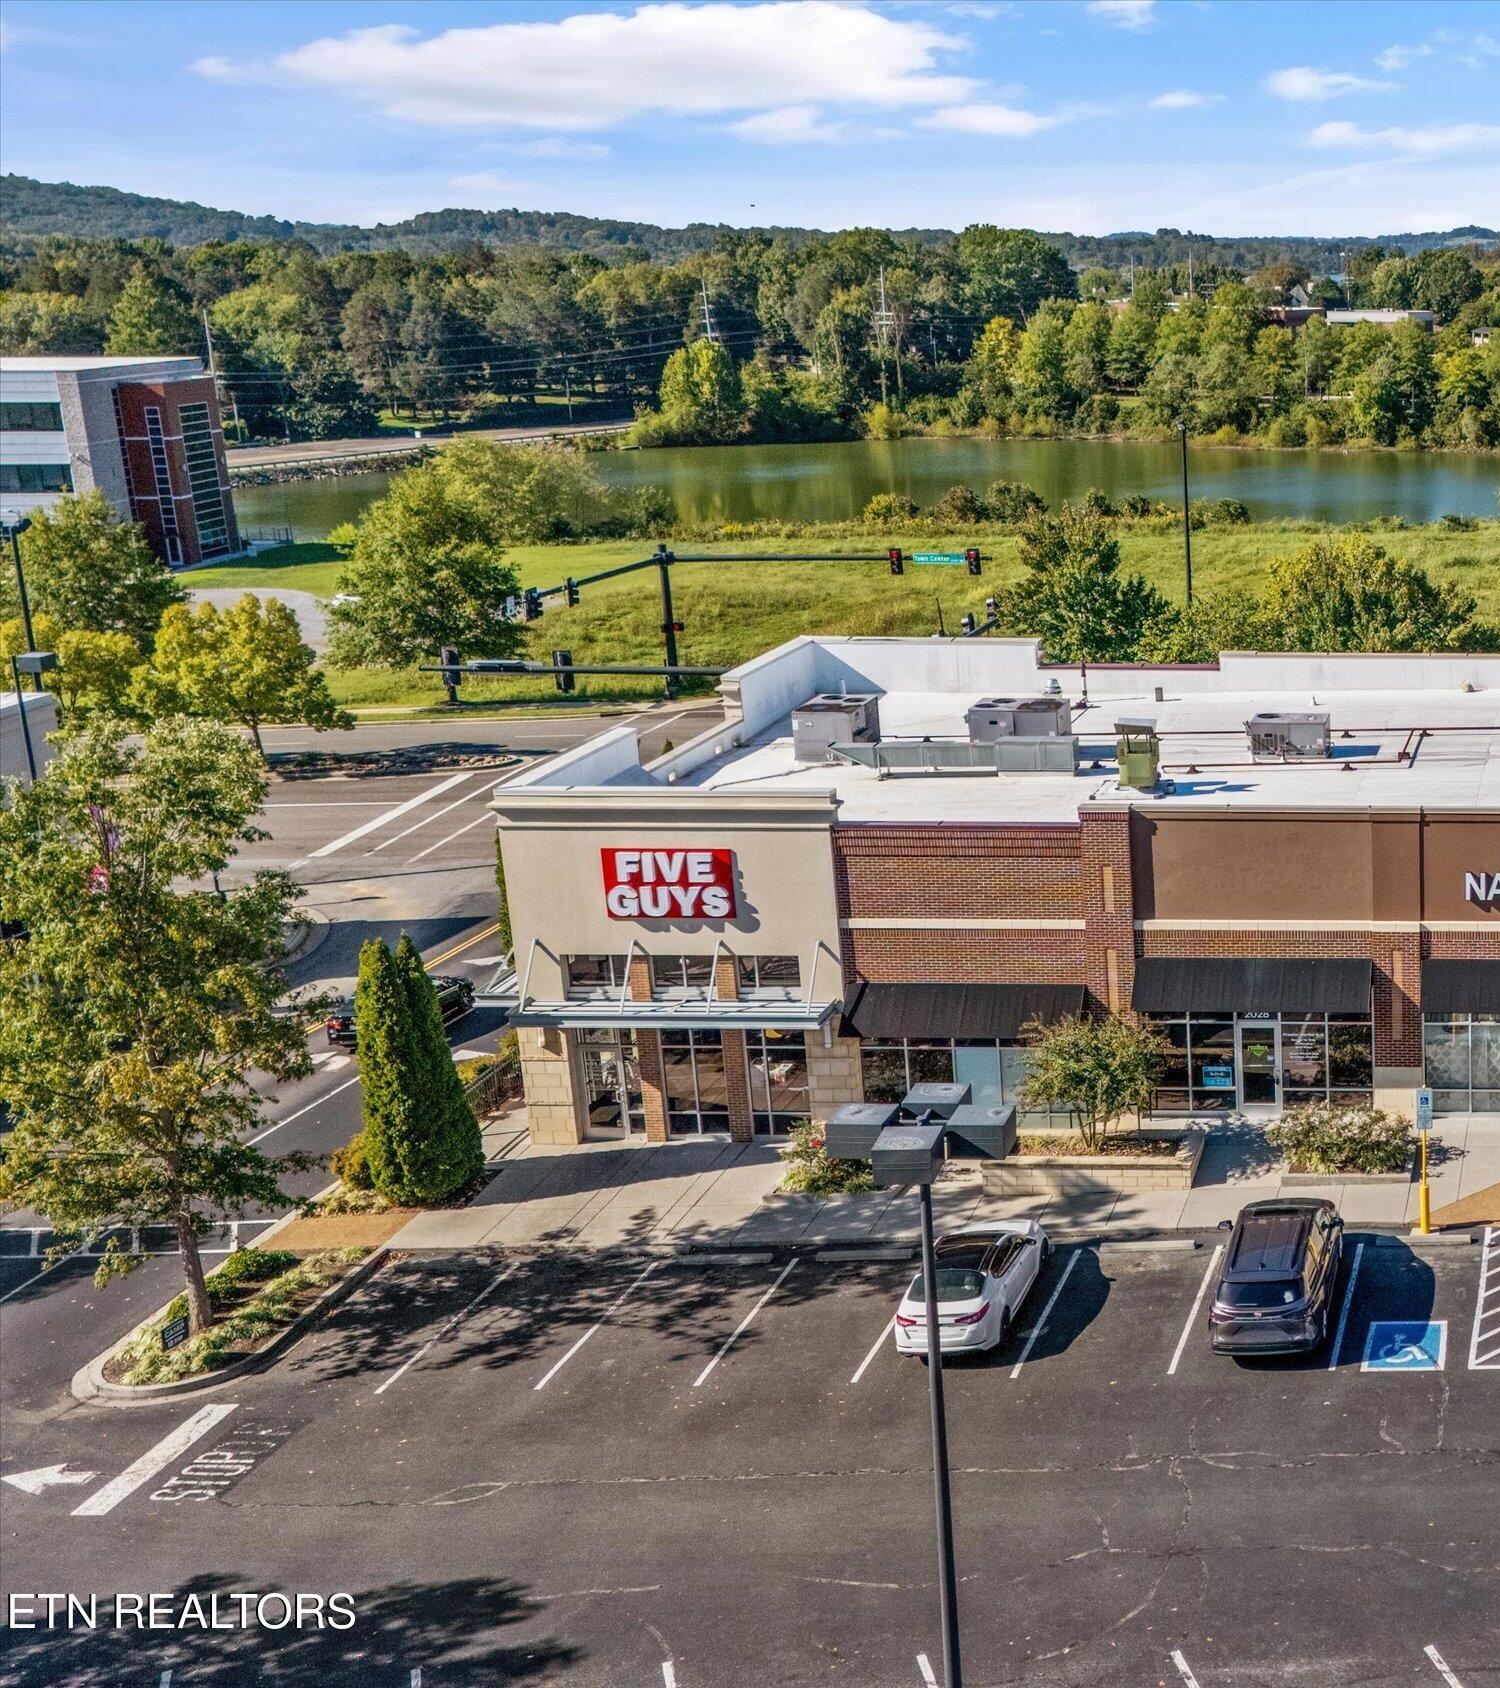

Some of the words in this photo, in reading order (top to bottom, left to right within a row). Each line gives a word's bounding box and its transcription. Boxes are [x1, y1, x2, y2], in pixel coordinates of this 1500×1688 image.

[615, 851, 715, 883] FIVE
[607, 885, 731, 917] GUYS
[1244, 1011, 1270, 1019] 2028
[150, 1451, 255, 1501] STOP
